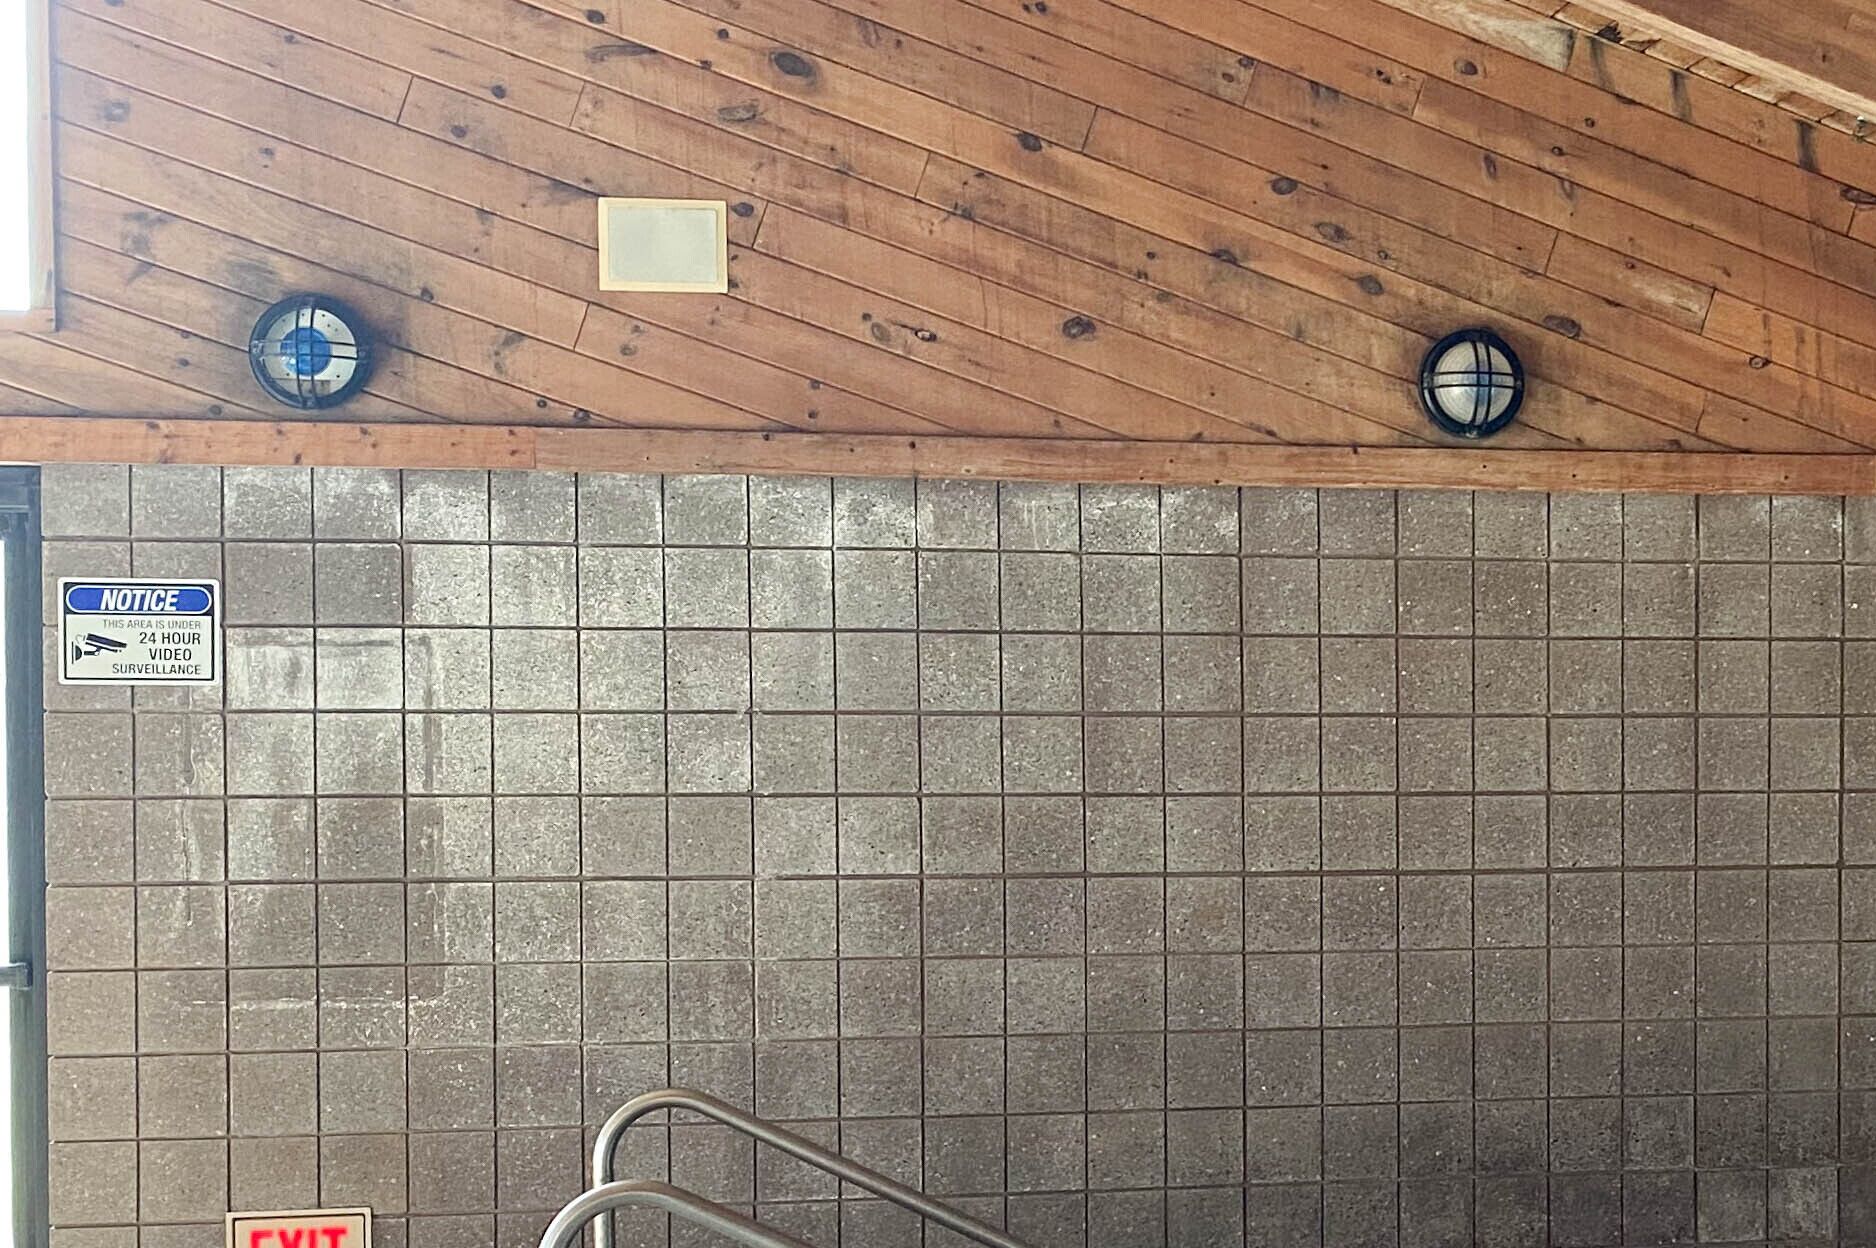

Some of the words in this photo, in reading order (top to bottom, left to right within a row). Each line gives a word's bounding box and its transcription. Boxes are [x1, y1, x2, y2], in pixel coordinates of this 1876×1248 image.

[100, 589, 179, 611] NOTICE
[103, 620, 124, 629] THIS
[127, 620, 152, 629] AREA
[155, 620, 164, 629] IS
[168, 620, 201, 629] UNDER
[139, 632, 156, 644] 24
[161, 632, 201, 645] HOUR
[149, 648, 192, 661] VIDEO
[112, 664, 201, 675] SURVEILLANCE
